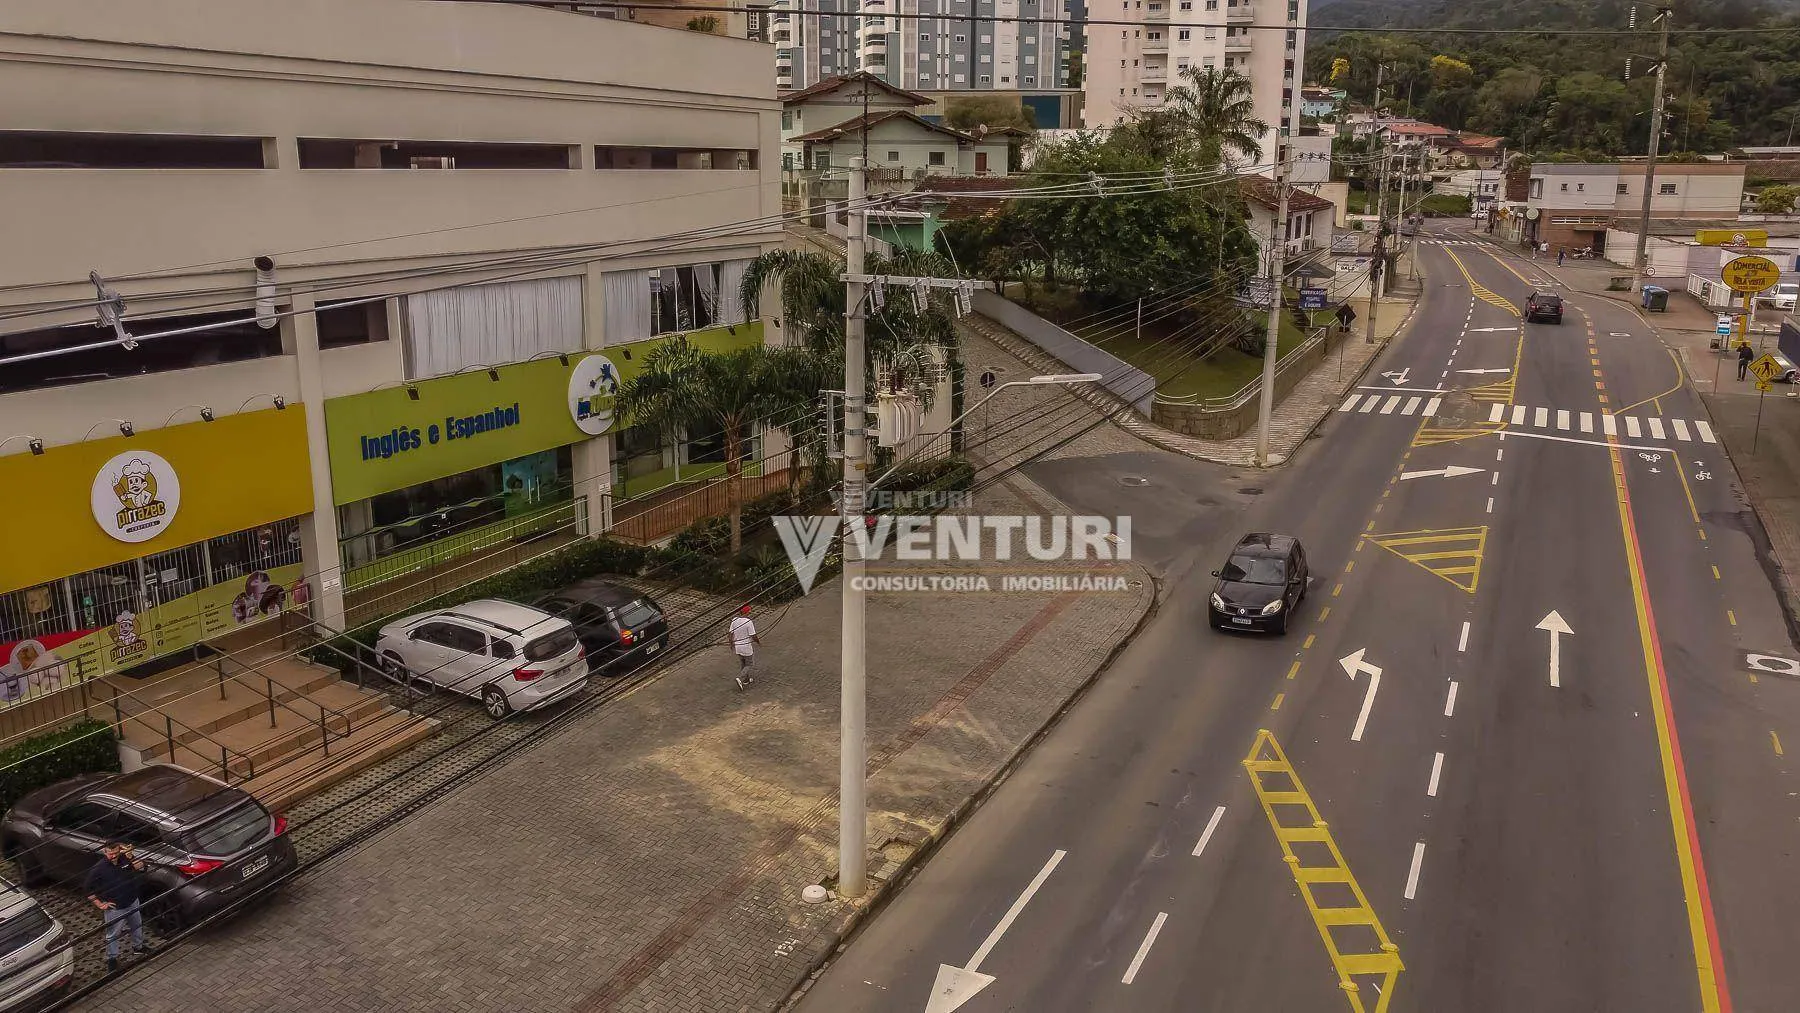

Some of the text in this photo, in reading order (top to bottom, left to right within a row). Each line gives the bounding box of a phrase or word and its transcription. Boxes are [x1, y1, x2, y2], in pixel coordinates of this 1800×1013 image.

[1733, 261, 1770, 272] COMERCIAL
[360, 402, 520, 461] Inglês e Espanhol
